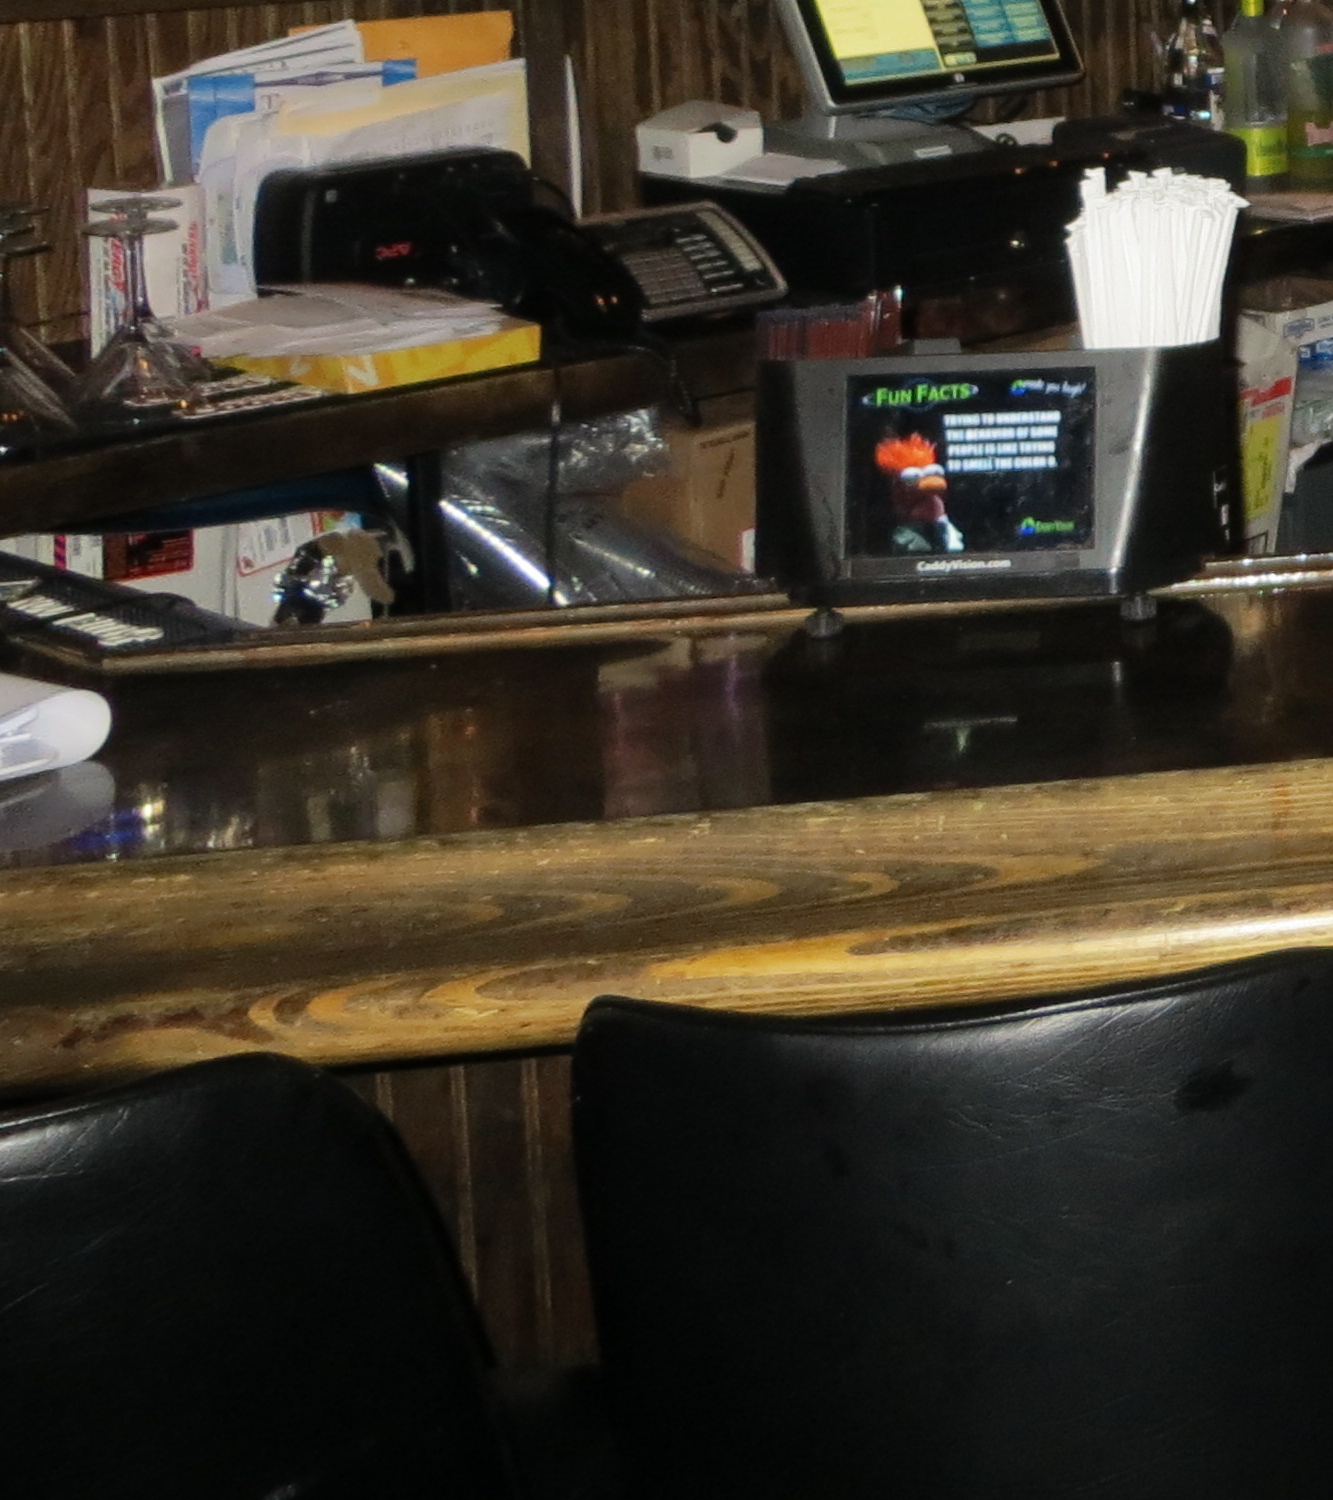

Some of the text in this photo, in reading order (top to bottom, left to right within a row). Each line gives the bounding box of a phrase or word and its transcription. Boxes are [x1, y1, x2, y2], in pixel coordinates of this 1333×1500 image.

[876, 383, 970, 407] FUN FACTS
[947, 442, 984, 457] PEOPLE
[916, 558, 1012, 574] CaddyVision.com
